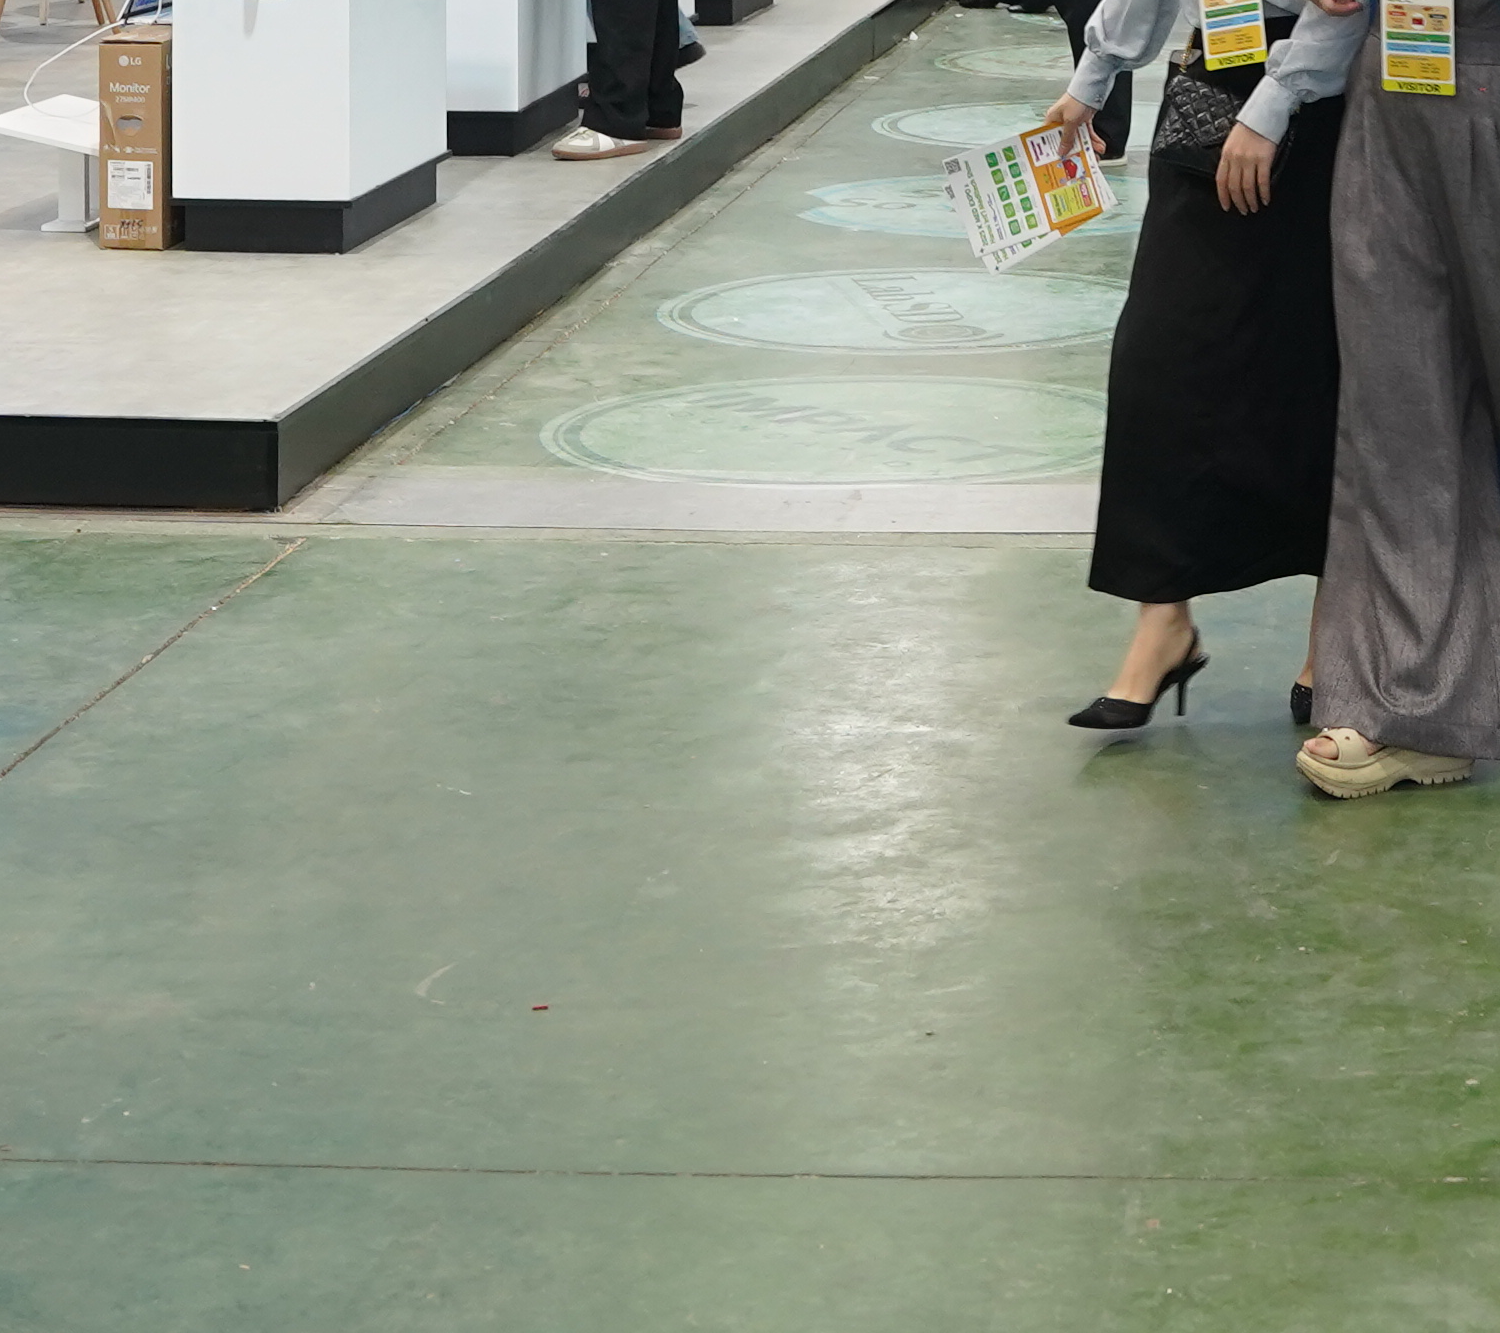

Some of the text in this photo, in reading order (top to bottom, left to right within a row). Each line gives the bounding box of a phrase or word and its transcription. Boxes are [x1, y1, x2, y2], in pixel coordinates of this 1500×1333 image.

[130, 57, 142, 66] LG
[109, 82, 151, 94] Monitor
[1397, 81, 1442, 93] VISITOR
